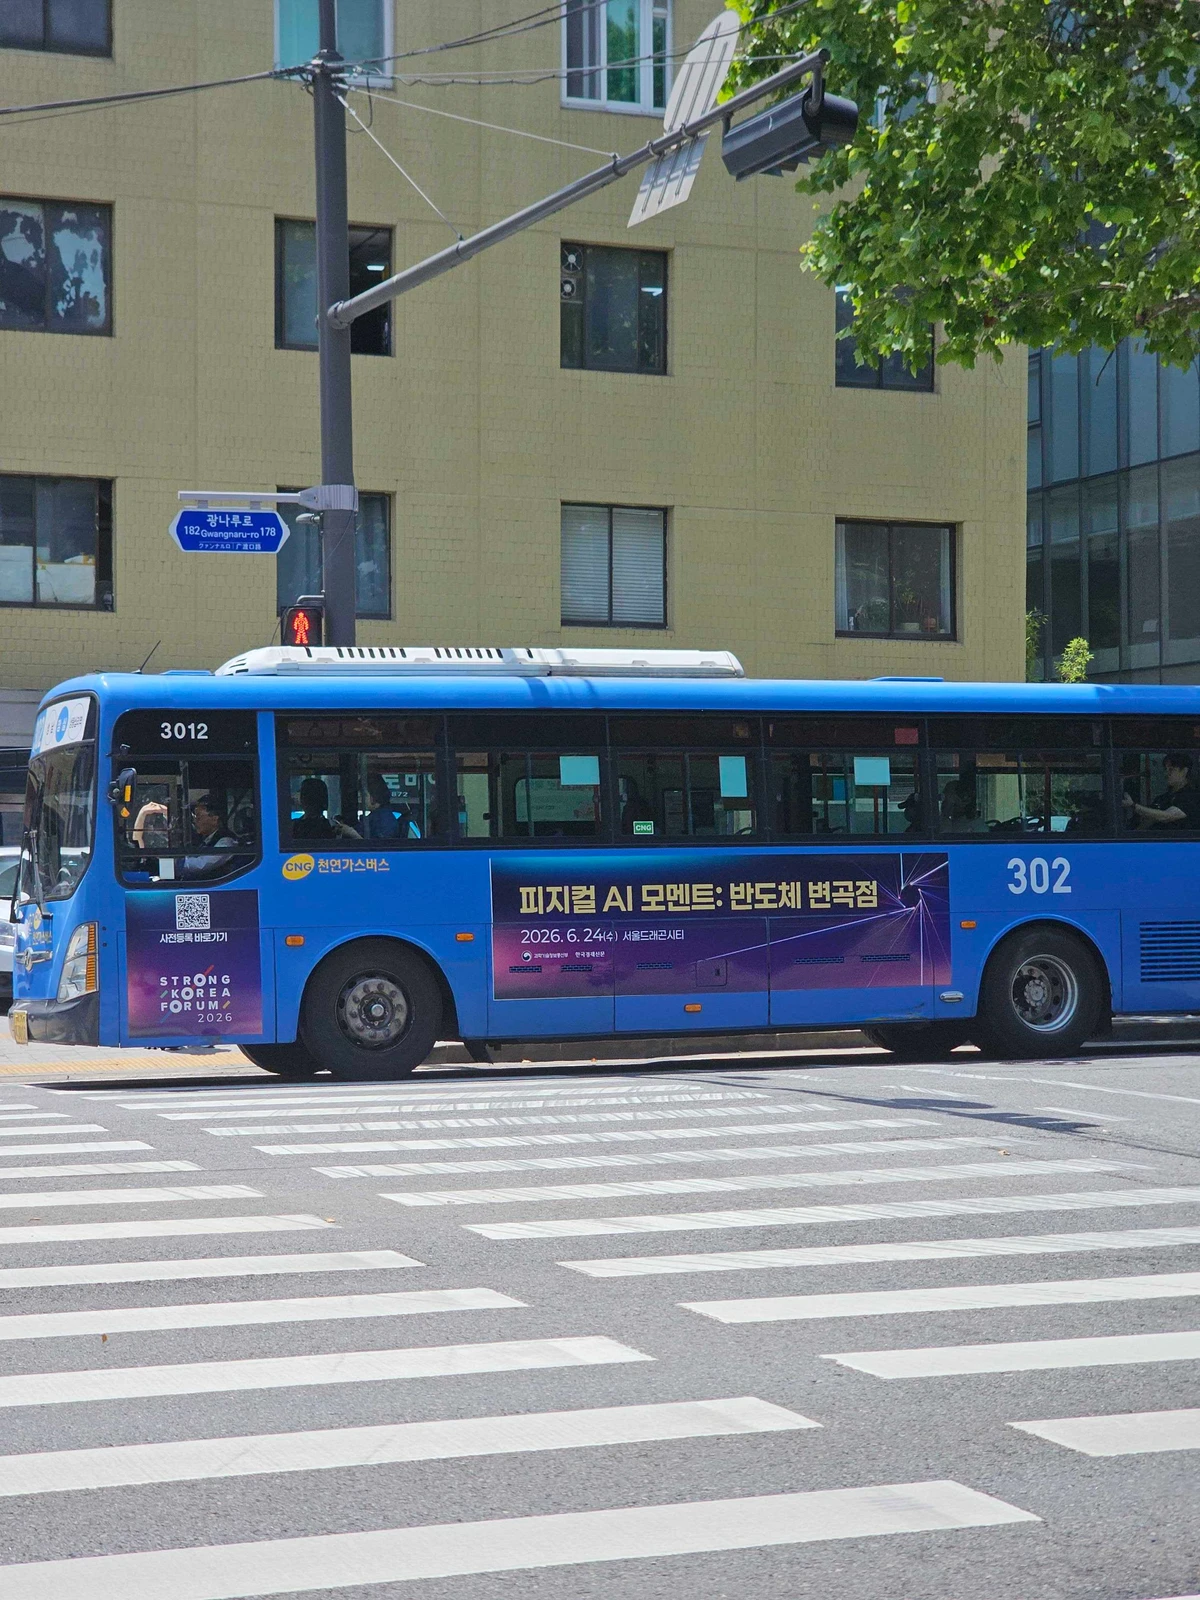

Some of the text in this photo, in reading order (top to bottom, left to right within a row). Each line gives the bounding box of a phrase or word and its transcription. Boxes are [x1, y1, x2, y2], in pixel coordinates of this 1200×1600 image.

[207, 514, 253, 527] 광나루로
[184, 526, 276, 540] 182 Gwangnaru-ro 178
[160, 722, 209, 739] 3012
[285, 862, 312, 872] CNG
[318, 858, 390, 873] 천연가스버스
[1007, 857, 1072, 894] 302
[519, 880, 878, 914] 피지컬 AI 모멘트: 반도체 변곡점
[159, 932, 228, 943] 사전등록 바로가기
[622, 929, 685, 942] 서울드래곤시티
[160, 973, 231, 987] STRONG
[171, 987, 231, 1000] KOREA
[160, 1000, 219, 1013] FORUM
[197, 1012, 233, 1023] 2026
